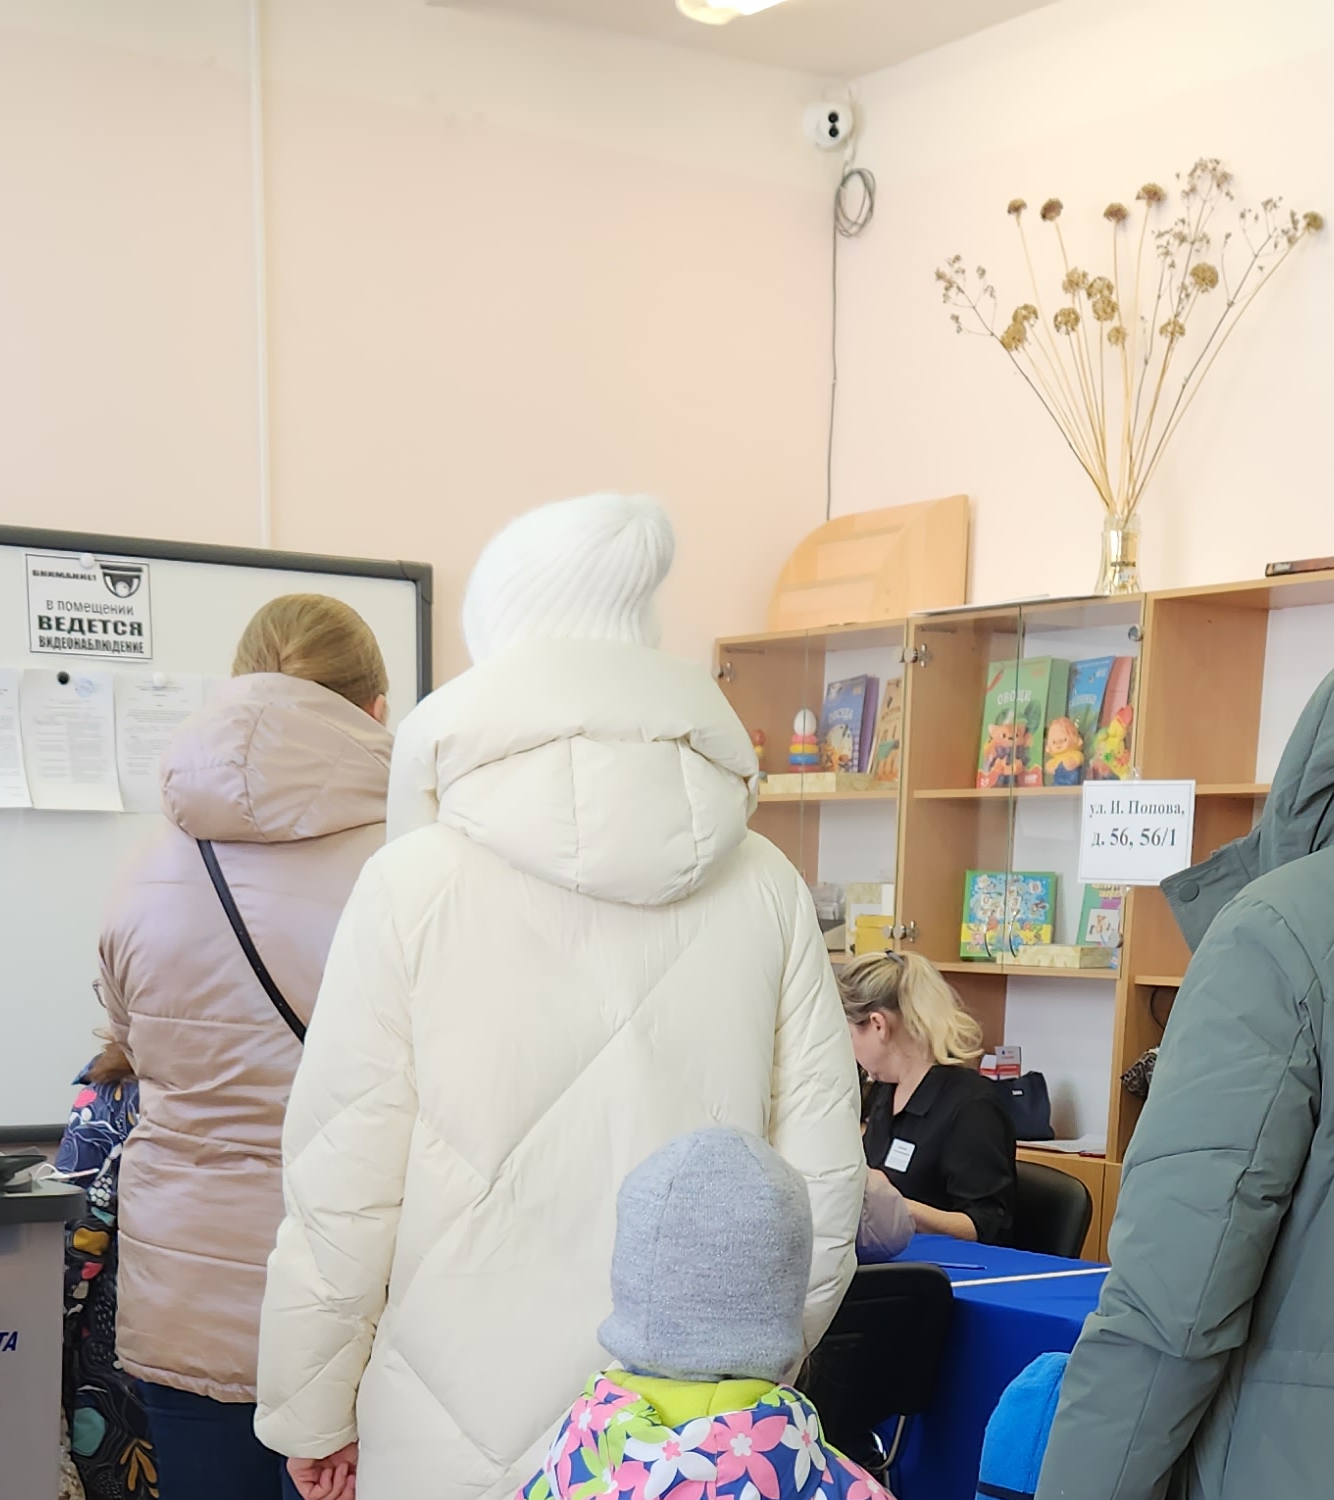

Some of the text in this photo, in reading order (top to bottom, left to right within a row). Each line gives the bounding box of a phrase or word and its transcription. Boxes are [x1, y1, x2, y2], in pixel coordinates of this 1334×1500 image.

[38, 615, 144, 637] ВЕДЕТСЯ
[39, 635, 145, 654] ВИДЕОНАБЛЮДЕНИЕ
[997, 690, 1032, 706] ОВОЩИ
[1089, 800, 1185, 818] ул. И. Попова,
[1091, 827, 1176, 850] д. 56, 56/1
